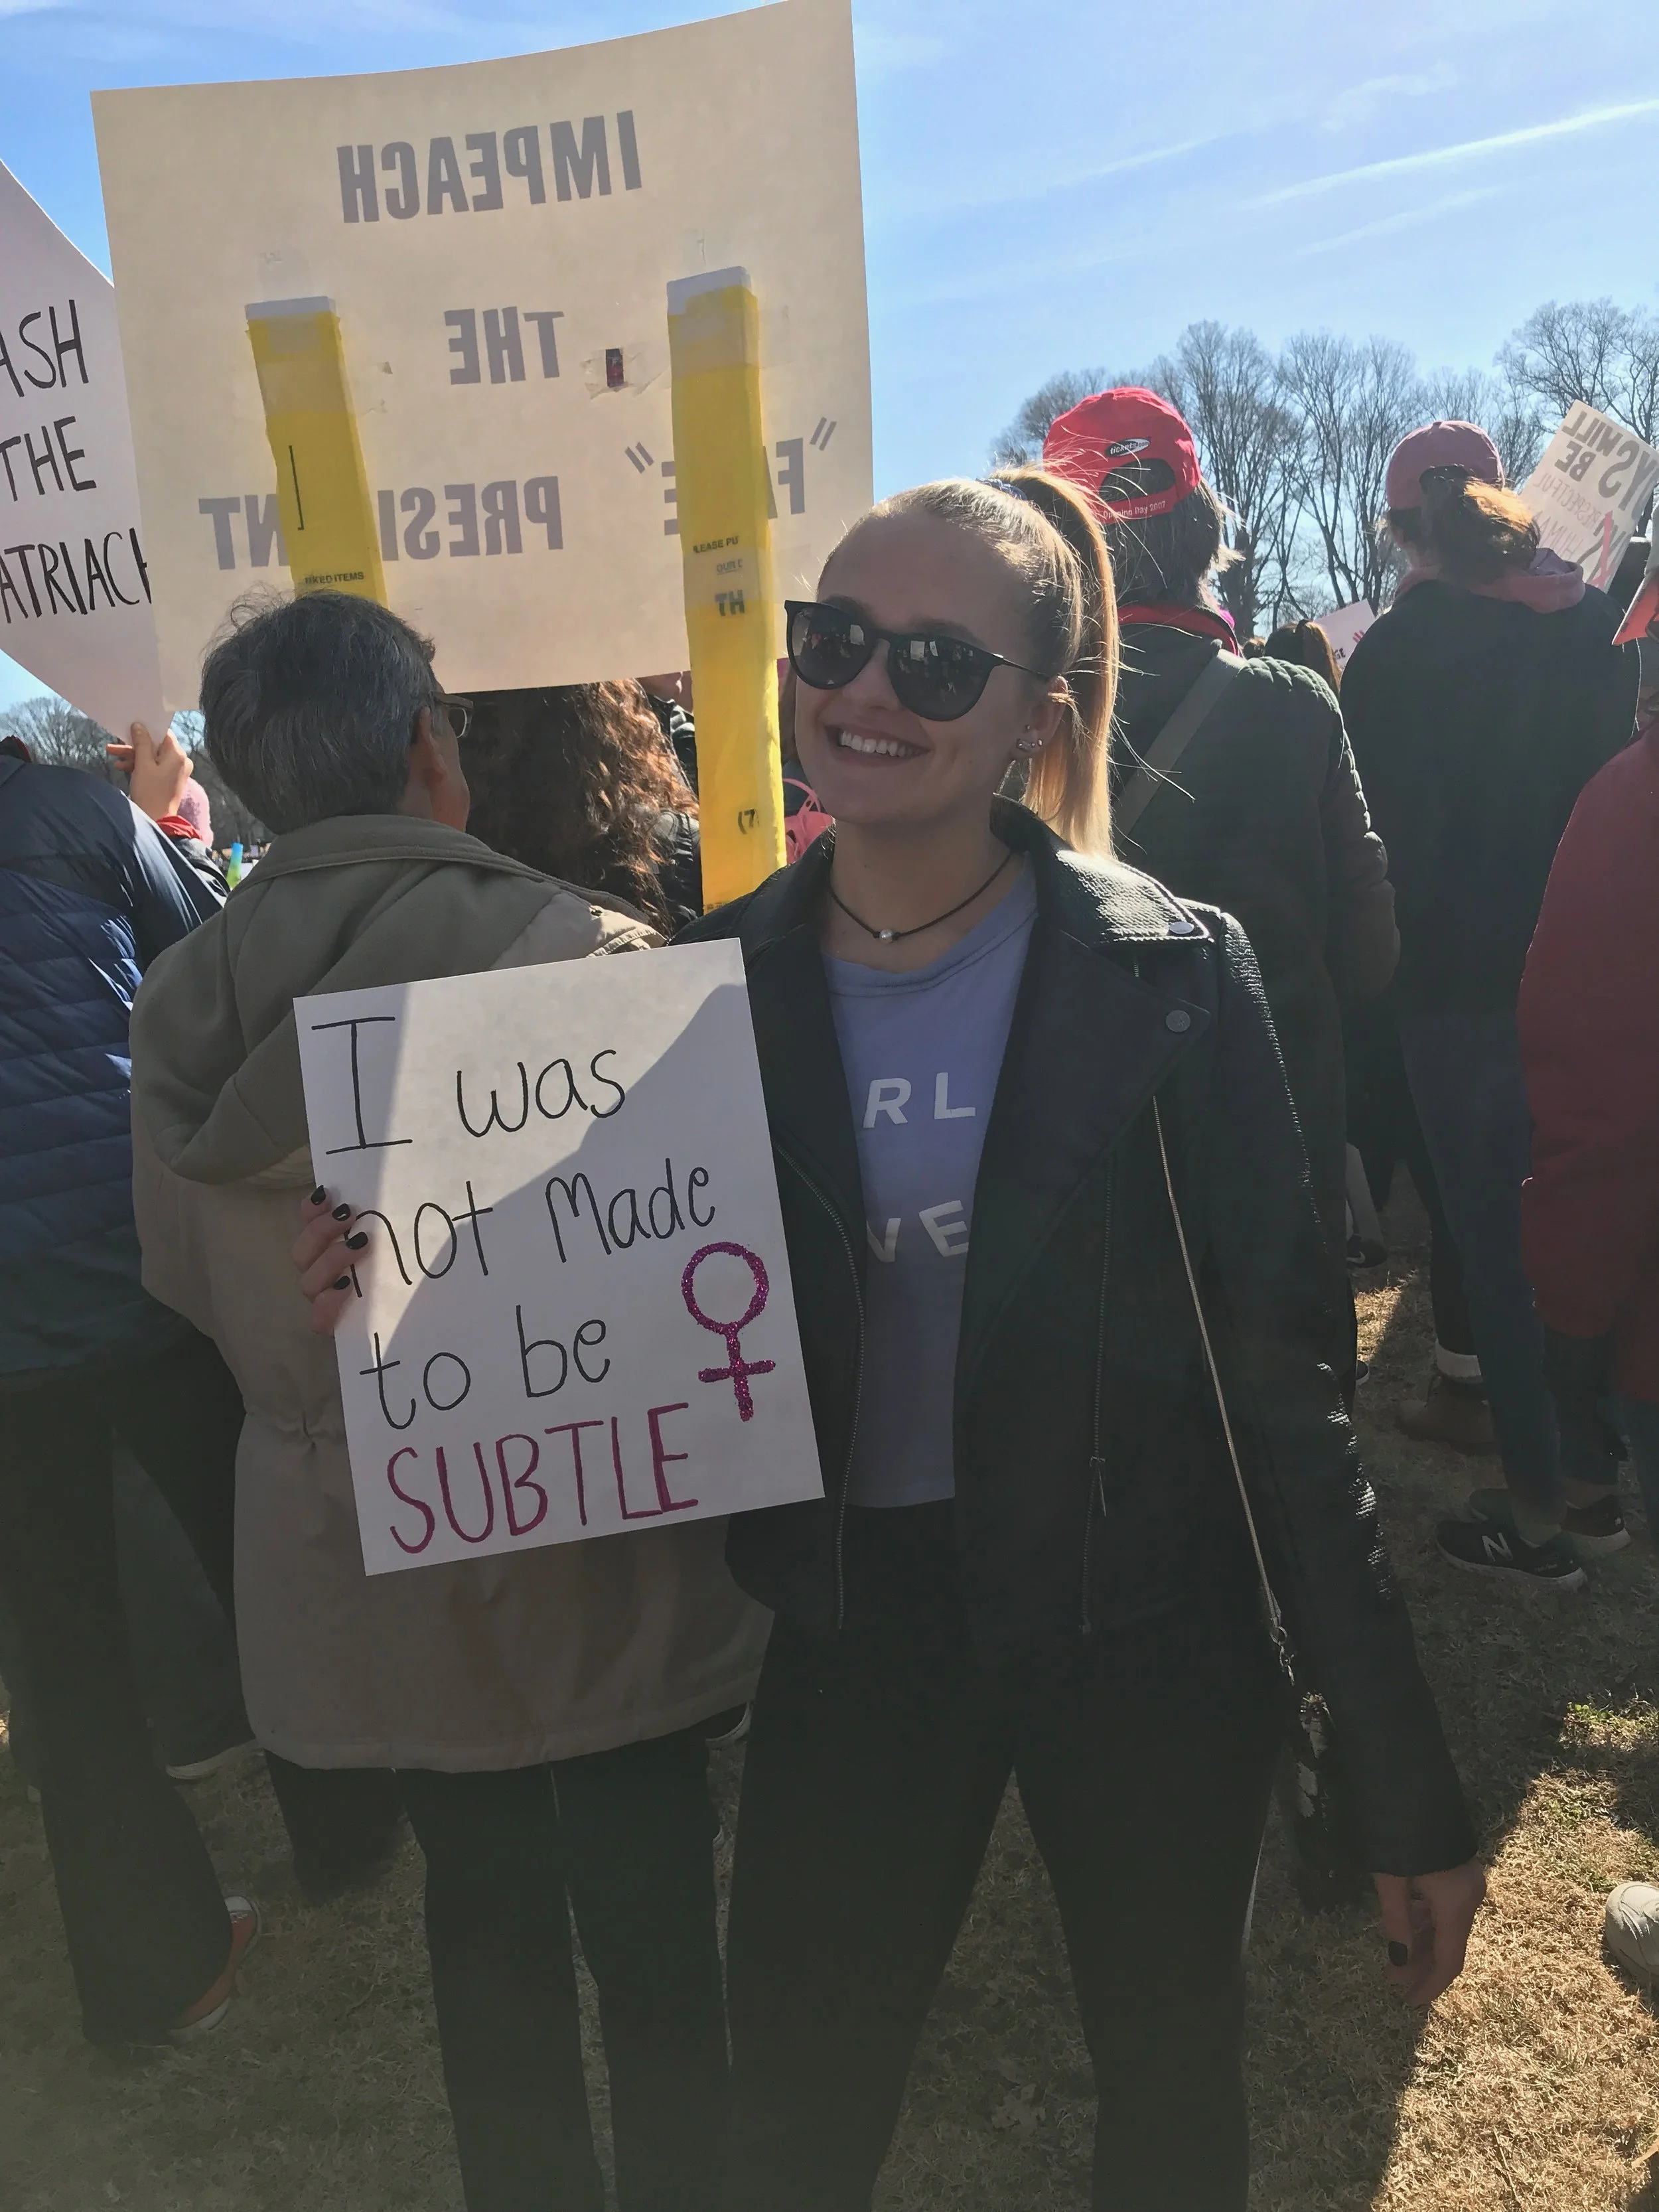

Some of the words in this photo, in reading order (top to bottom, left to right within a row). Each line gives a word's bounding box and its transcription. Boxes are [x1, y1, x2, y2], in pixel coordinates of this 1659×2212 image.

[0, 416, 97, 502] THE
[1104, 509, 1132, 520] Opning
[1150, 501, 1166, 512] 2007
[334, 571, 364, 582] ITEMS
[312, 1016, 413, 1154] I
[457, 1049, 625, 1138] was
[863, 1072, 976, 1129] RL
[343, 1181, 493, 1298] not
[360, 1332, 471, 1430] to
[516, 1305, 610, 1398] be
[387, 1402, 699, 1554] SUBTLE
